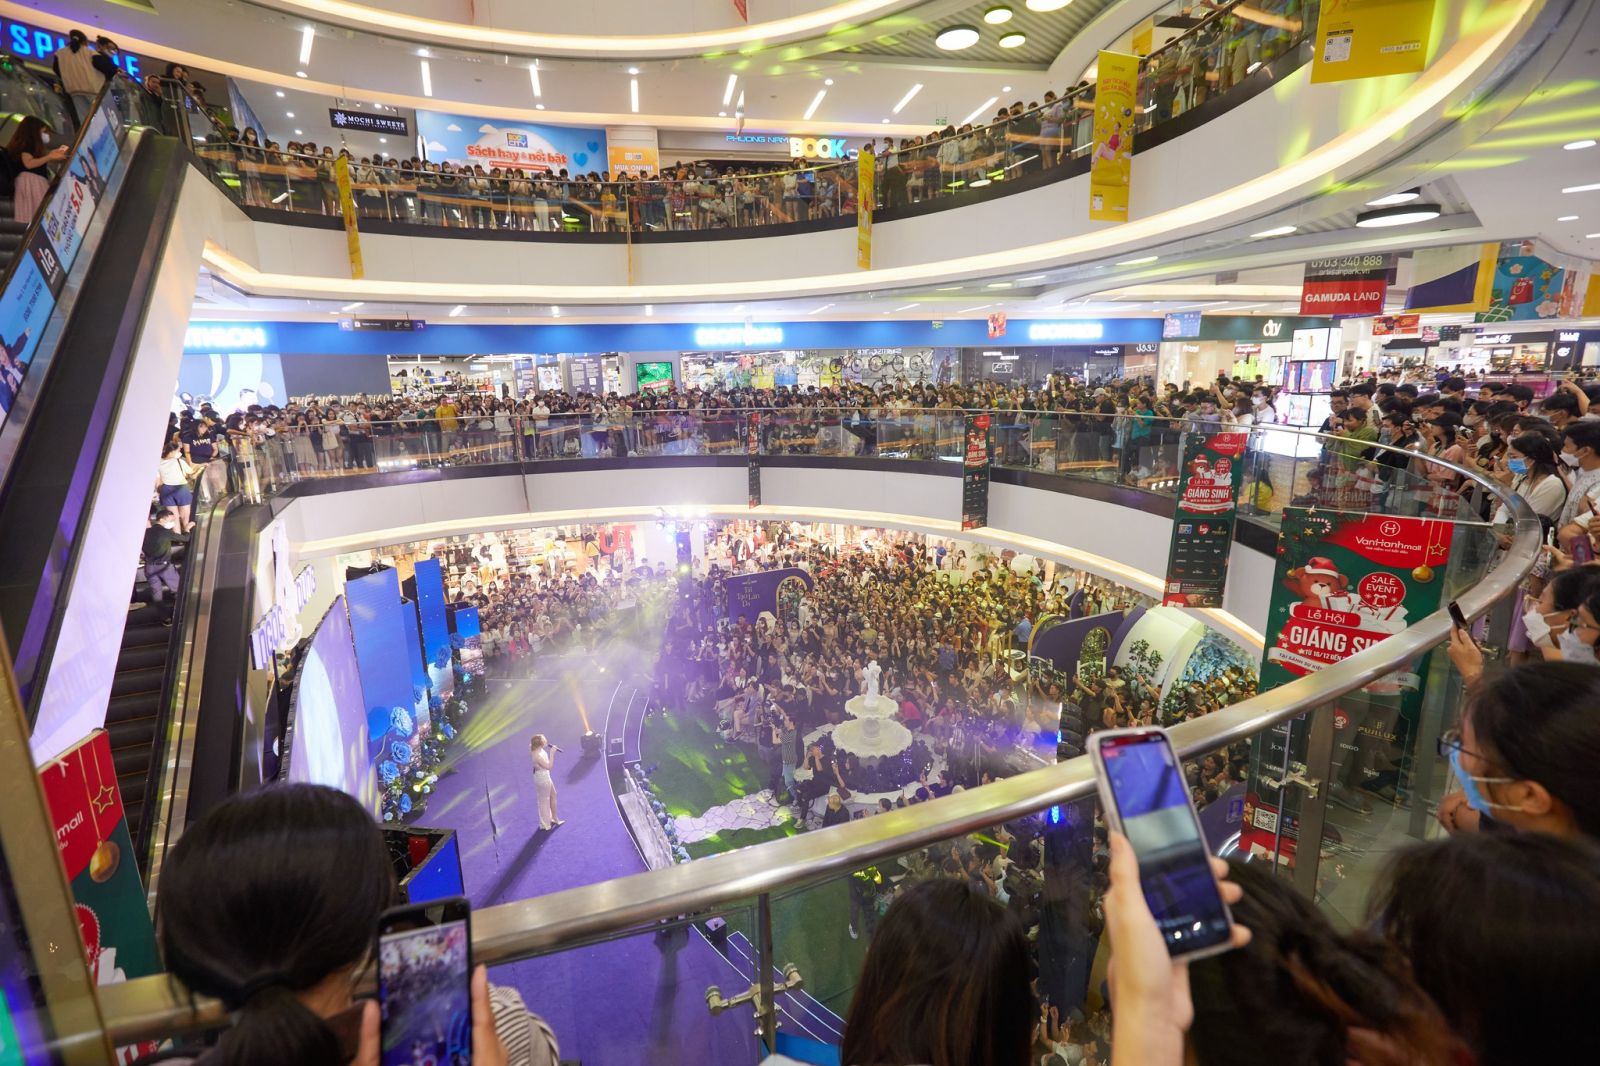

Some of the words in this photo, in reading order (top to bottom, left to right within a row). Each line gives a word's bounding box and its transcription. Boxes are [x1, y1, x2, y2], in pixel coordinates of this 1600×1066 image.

[348, 115, 374, 125] MOCHI
[376, 119, 405, 129] SWEETS
[467, 145, 496, 157] Sách
[498, 148, 519, 161] hay
[789, 137, 846, 159] BOOK
[1340, 256, 1361, 267] 340
[1362, 255, 1383, 266] 888
[1305, 292, 1351, 303] GAMUDA
[1353, 291, 1381, 301] LAND
[1187, 487, 1210, 499] GIÁNG
[1211, 488, 1230, 499] SINH
[1355, 536, 1422, 551] VanHanhmall
[1371, 575, 1396, 586] SALE
[1366, 583, 1399, 594] EVENT
[1307, 609, 1322, 619] Lễ
[1325, 611, 1346, 624] Hội
[1289, 625, 1348, 653] GIÁNG
